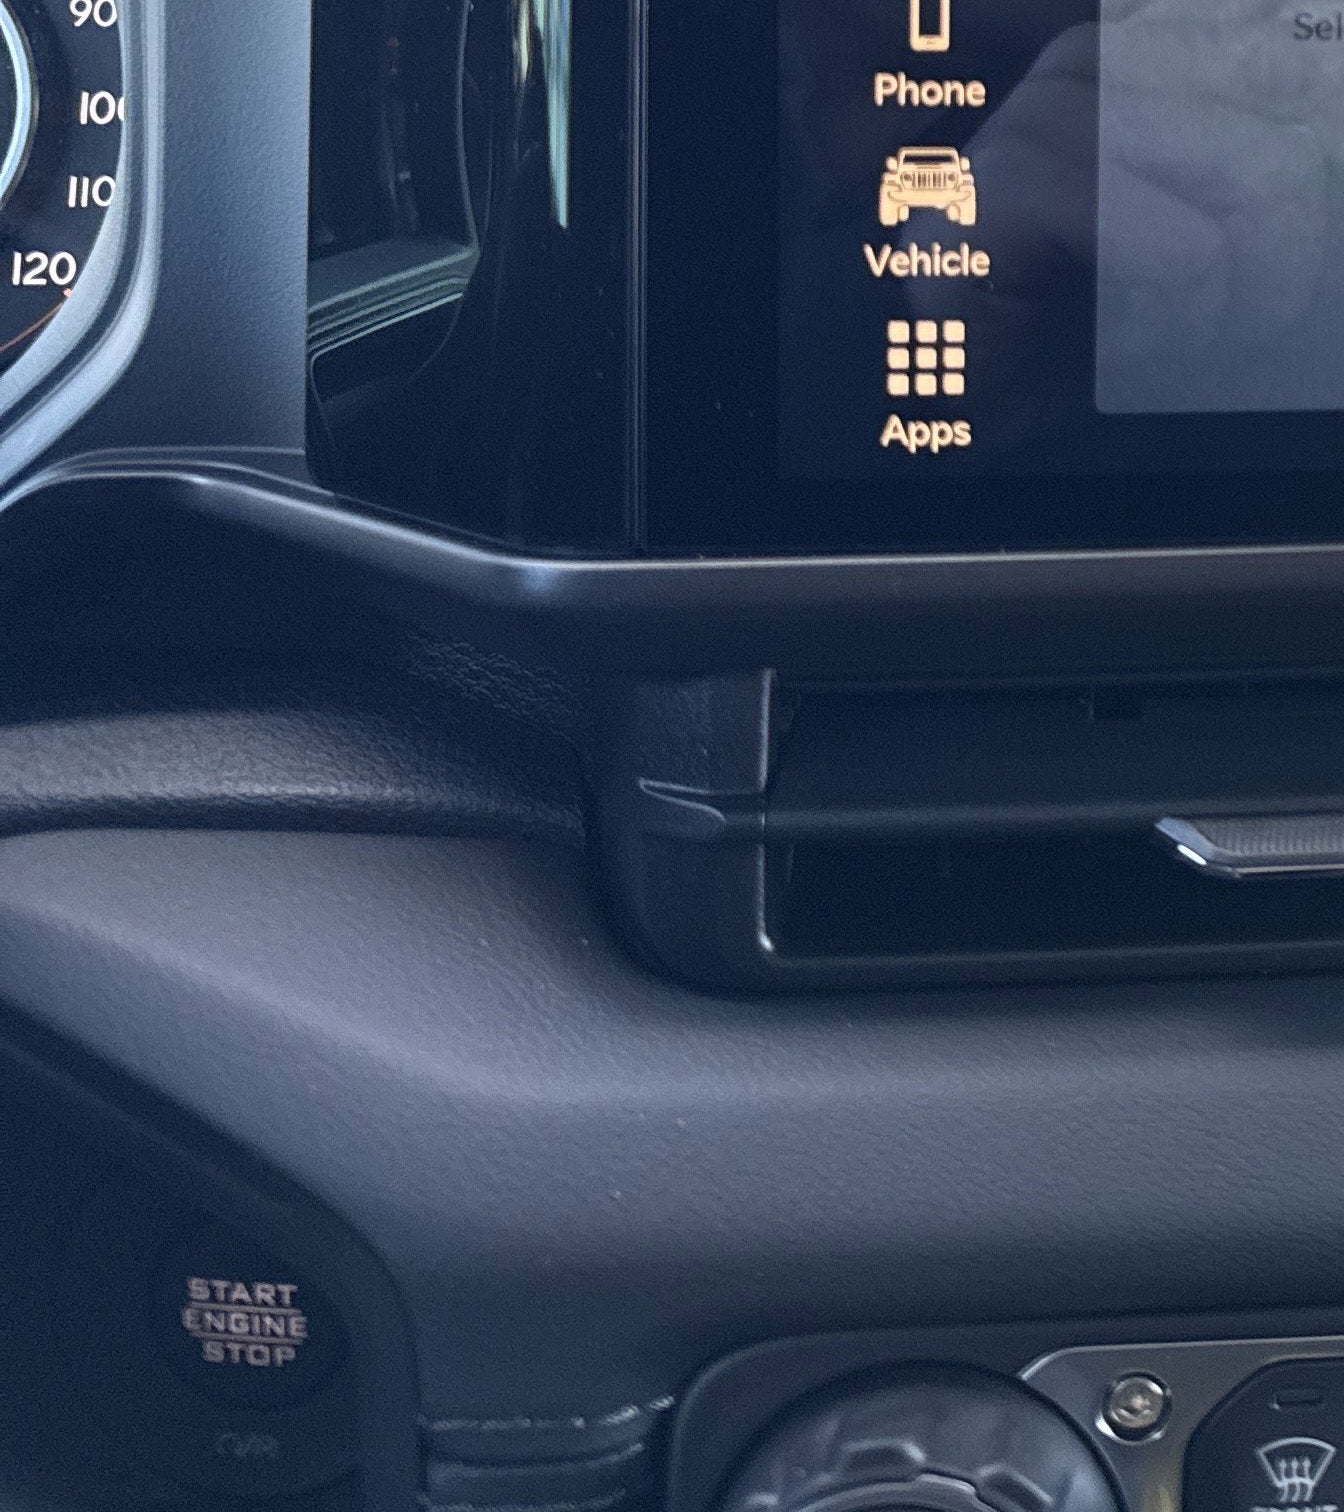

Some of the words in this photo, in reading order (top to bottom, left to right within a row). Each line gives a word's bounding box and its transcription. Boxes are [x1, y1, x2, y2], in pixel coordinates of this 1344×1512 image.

[874, 72, 986, 107] Phone
[68, 175, 117, 208] 110
[11, 251, 77, 287] 120
[863, 242, 991, 278] Vehicle
[879, 413, 972, 454] Apps
[187, 1277, 298, 1306] START
[183, 1306, 308, 1338] ENGINE
[202, 1340, 296, 1368] STOP
